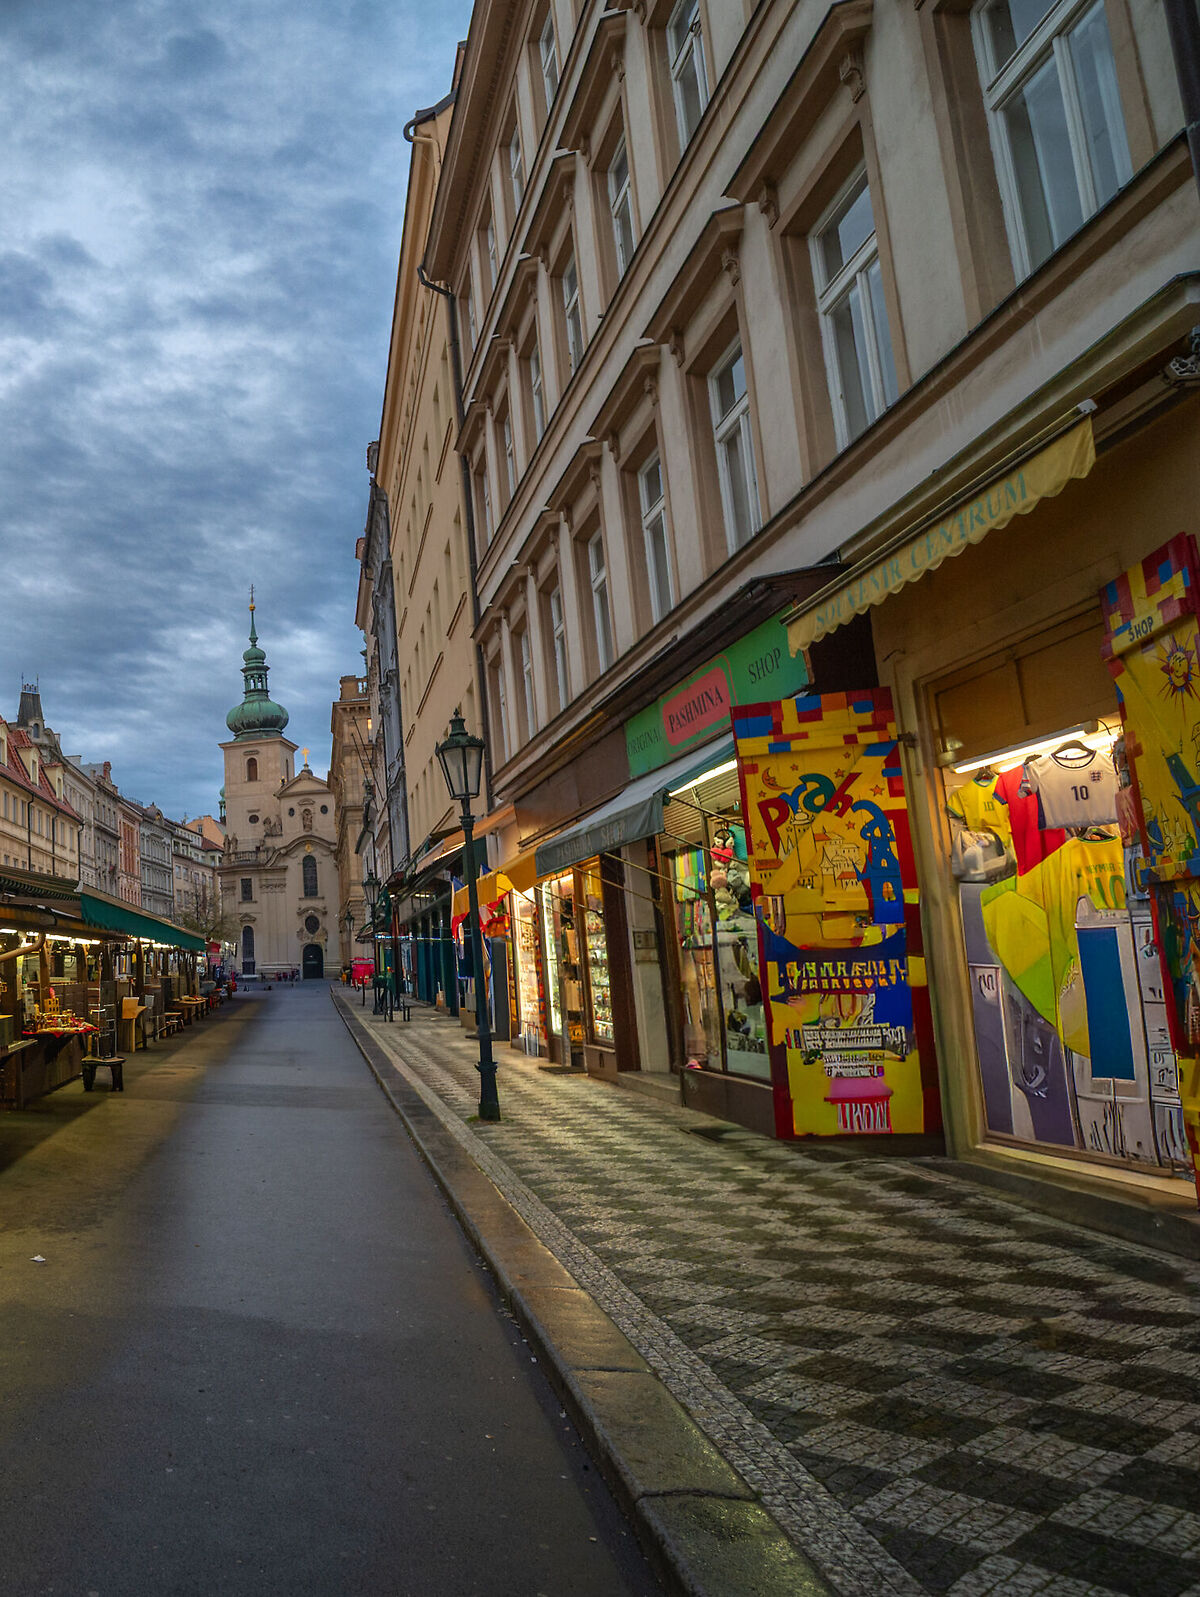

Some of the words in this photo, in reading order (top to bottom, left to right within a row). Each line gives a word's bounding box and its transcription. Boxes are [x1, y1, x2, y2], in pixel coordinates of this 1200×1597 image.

[815, 558, 903, 632] SOUVENIR
[910, 471, 1029, 570] CENTRUM
[1127, 615, 1154, 643] SHOP
[668, 685, 725, 735] PASHMINA
[748, 647, 782, 685] SHOP
[757, 772, 898, 860] Praha
[1070, 784, 1090, 802] 10
[1094, 875, 1127, 909] 10
